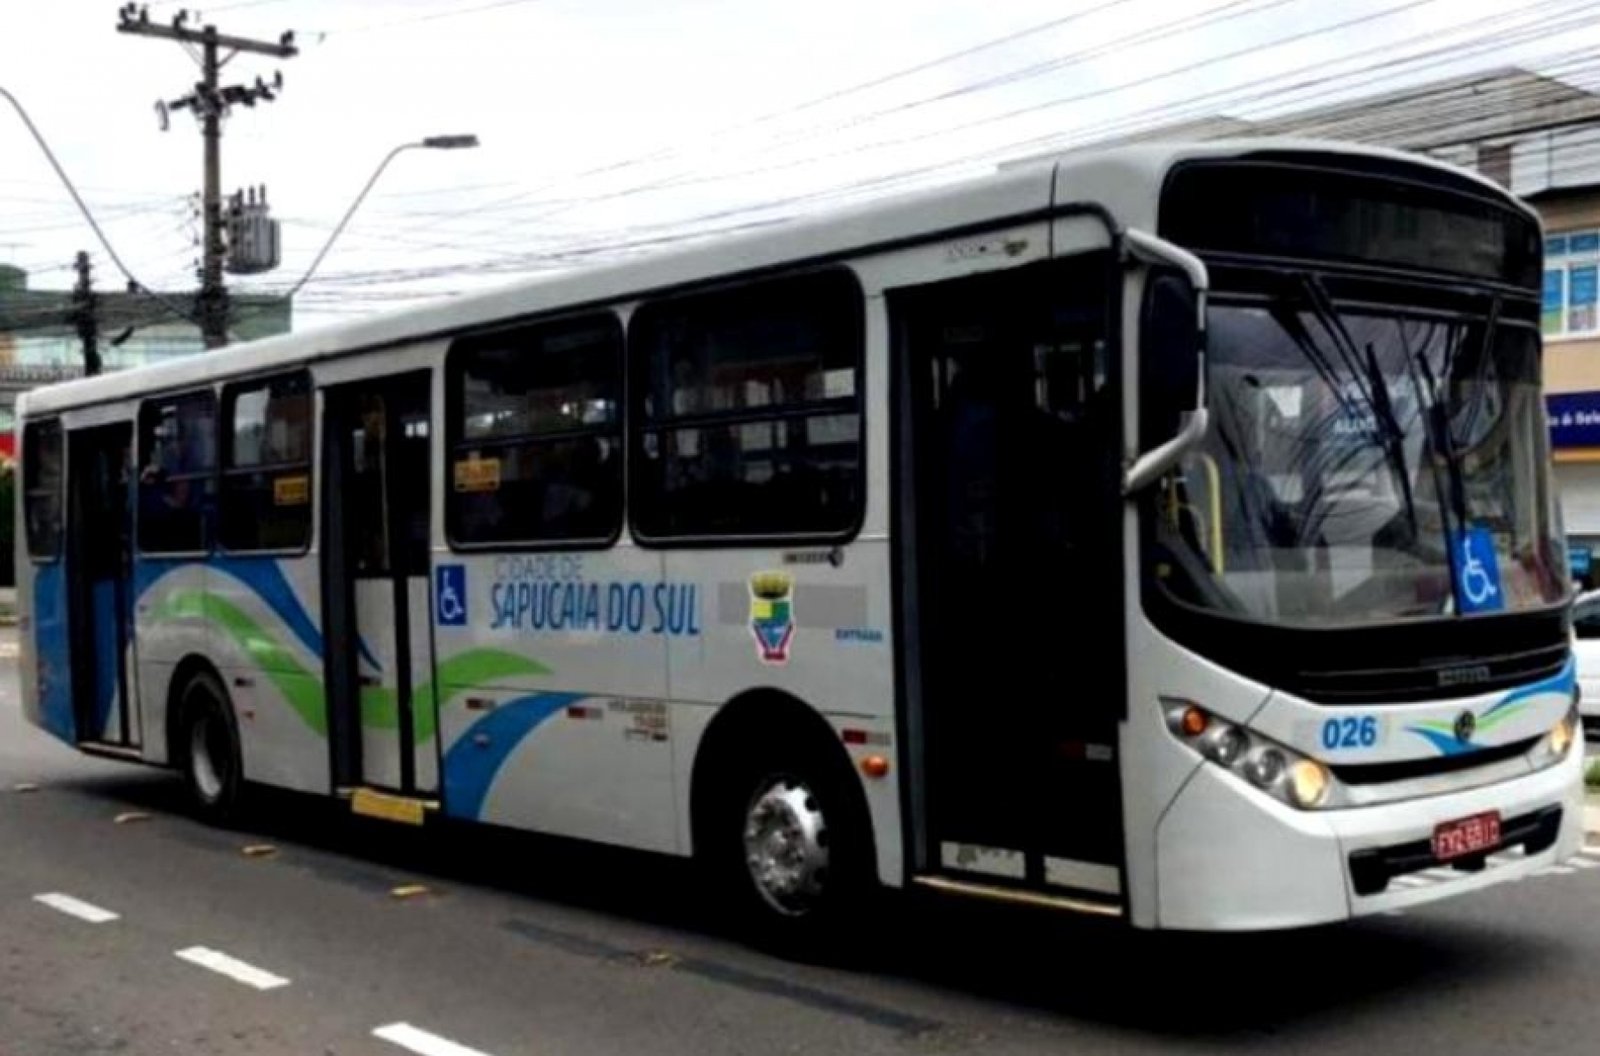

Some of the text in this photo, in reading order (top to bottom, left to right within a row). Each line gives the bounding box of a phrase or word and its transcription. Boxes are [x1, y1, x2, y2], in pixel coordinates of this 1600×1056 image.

[495, 554, 584, 580] CIDADE DE
[490, 581, 699, 635] SAPUCAIA DO SUL
[1322, 715, 1377, 750] 026
